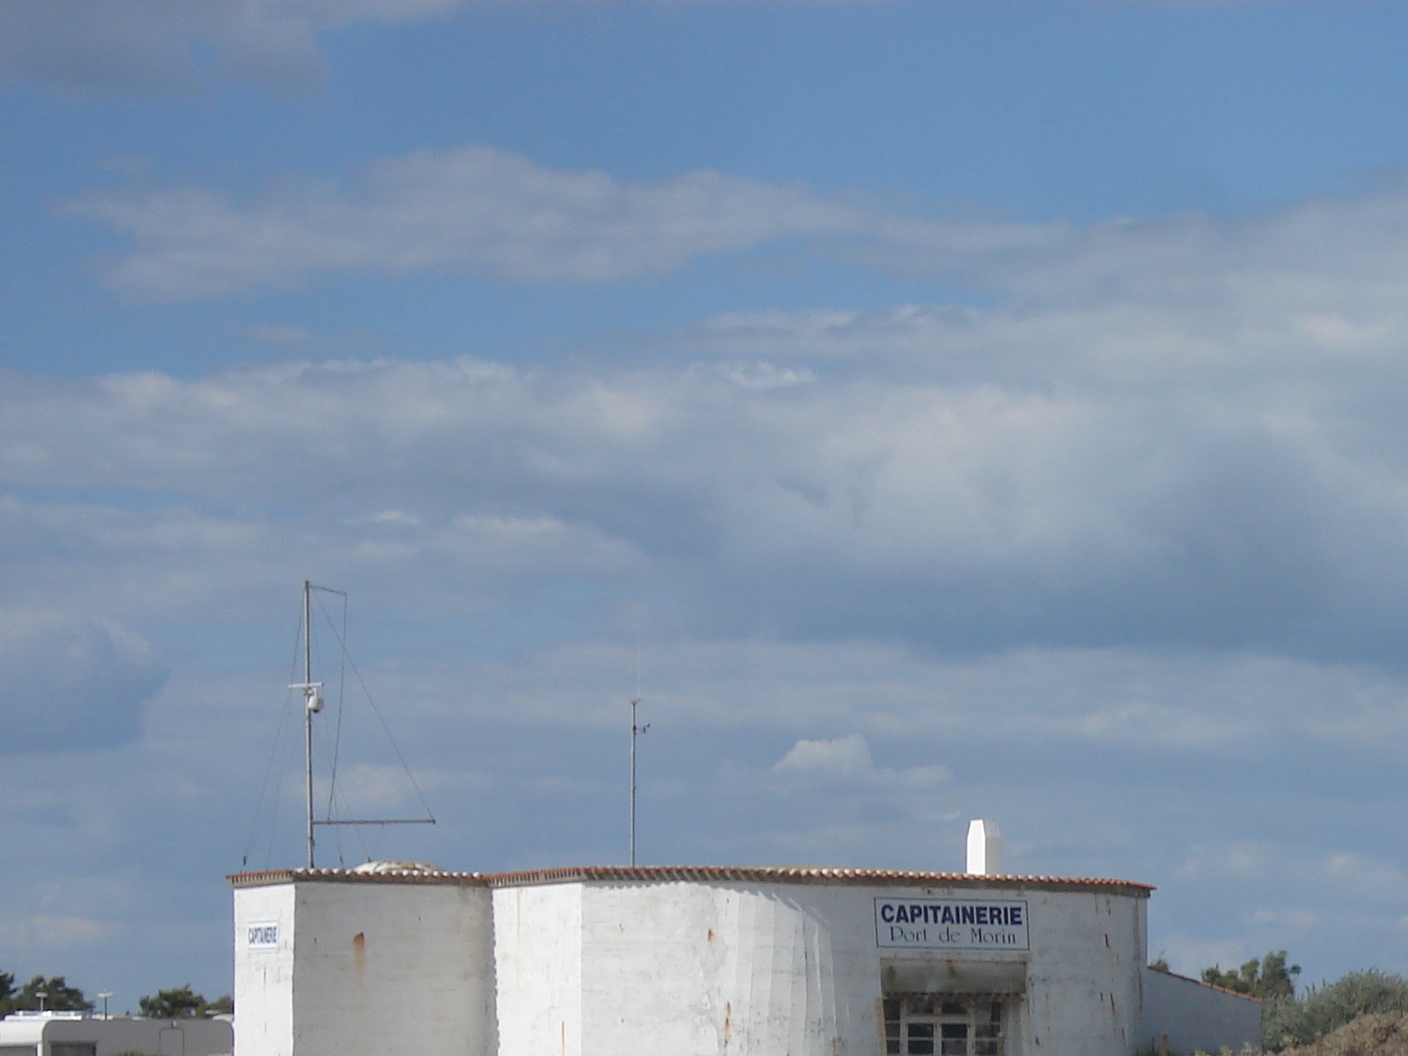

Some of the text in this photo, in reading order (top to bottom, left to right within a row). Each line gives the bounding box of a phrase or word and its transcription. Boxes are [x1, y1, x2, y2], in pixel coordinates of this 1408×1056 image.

[881, 903, 1023, 926] CAPITAINERIE
[890, 926, 1016, 945] Port de Morin
